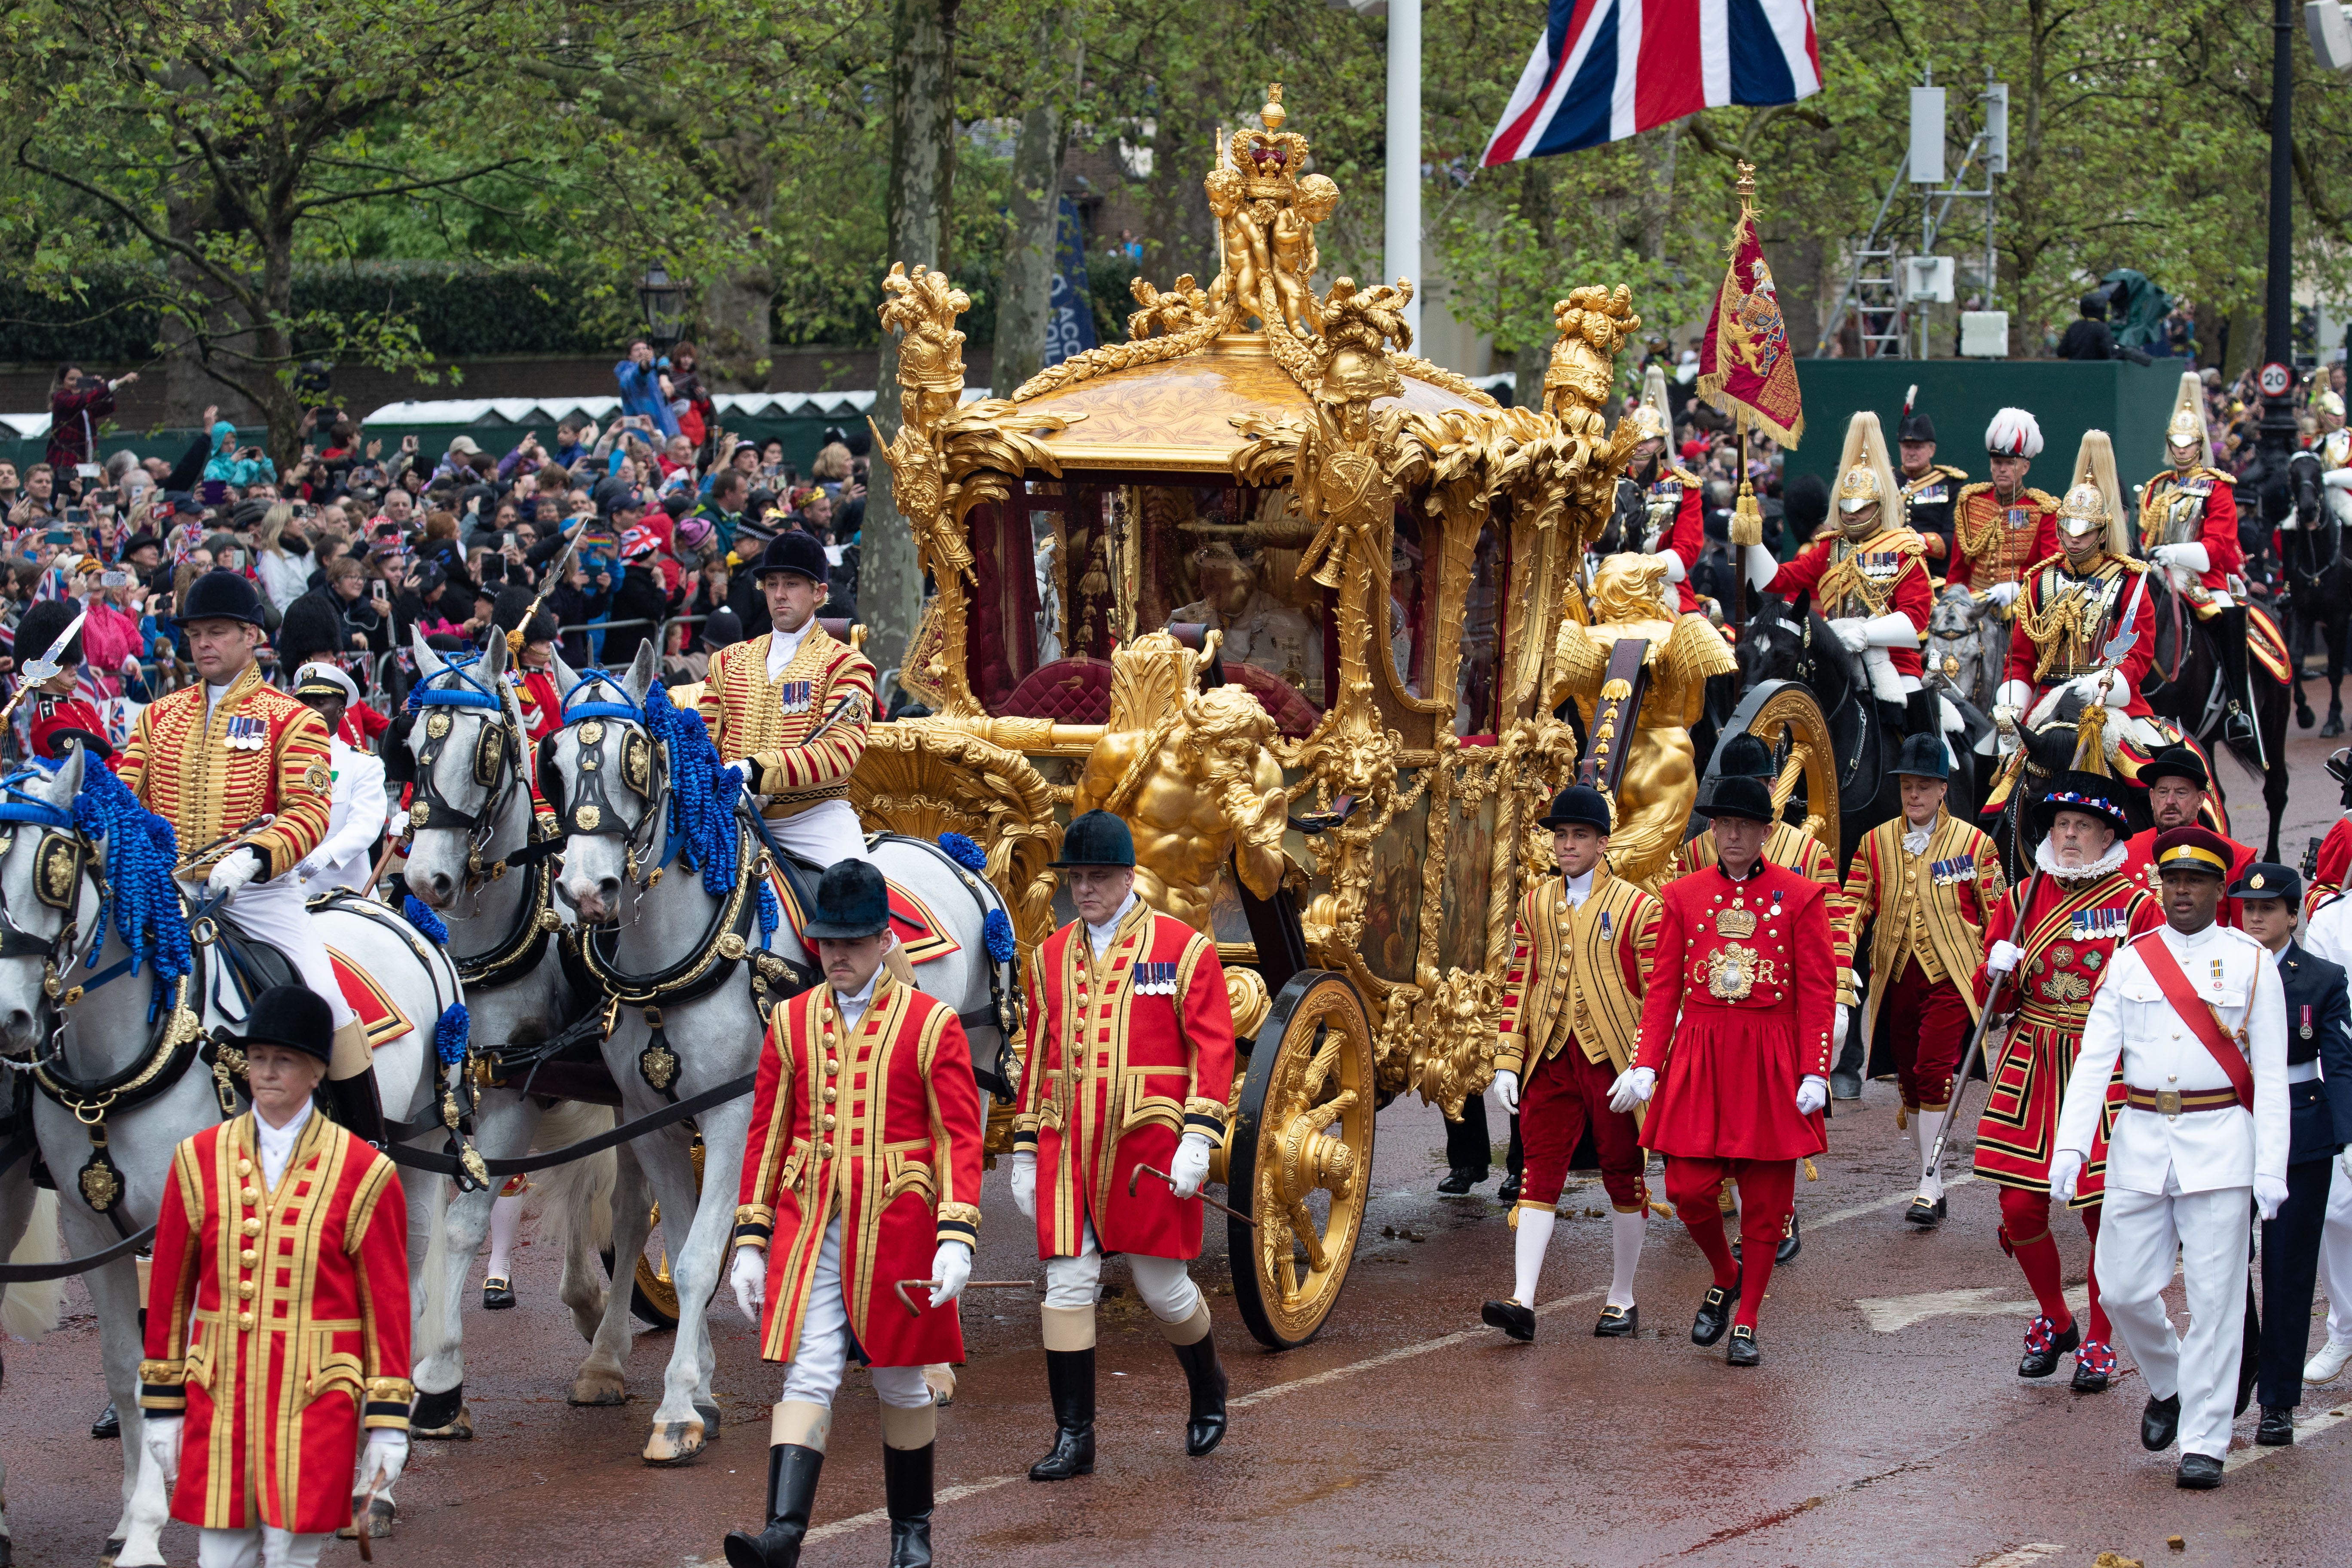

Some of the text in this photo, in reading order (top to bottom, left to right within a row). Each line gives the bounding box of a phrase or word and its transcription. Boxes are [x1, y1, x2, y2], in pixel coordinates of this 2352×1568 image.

[1756, 350, 1788, 404] DETTINGEN PENINSULA
[1761, 389, 1774, 407] RELIEF
[1773, 356, 1791, 384] KIMBERLEY
[2265, 373, 2285, 386] 20
[1767, 394, 1778, 410] MONS
